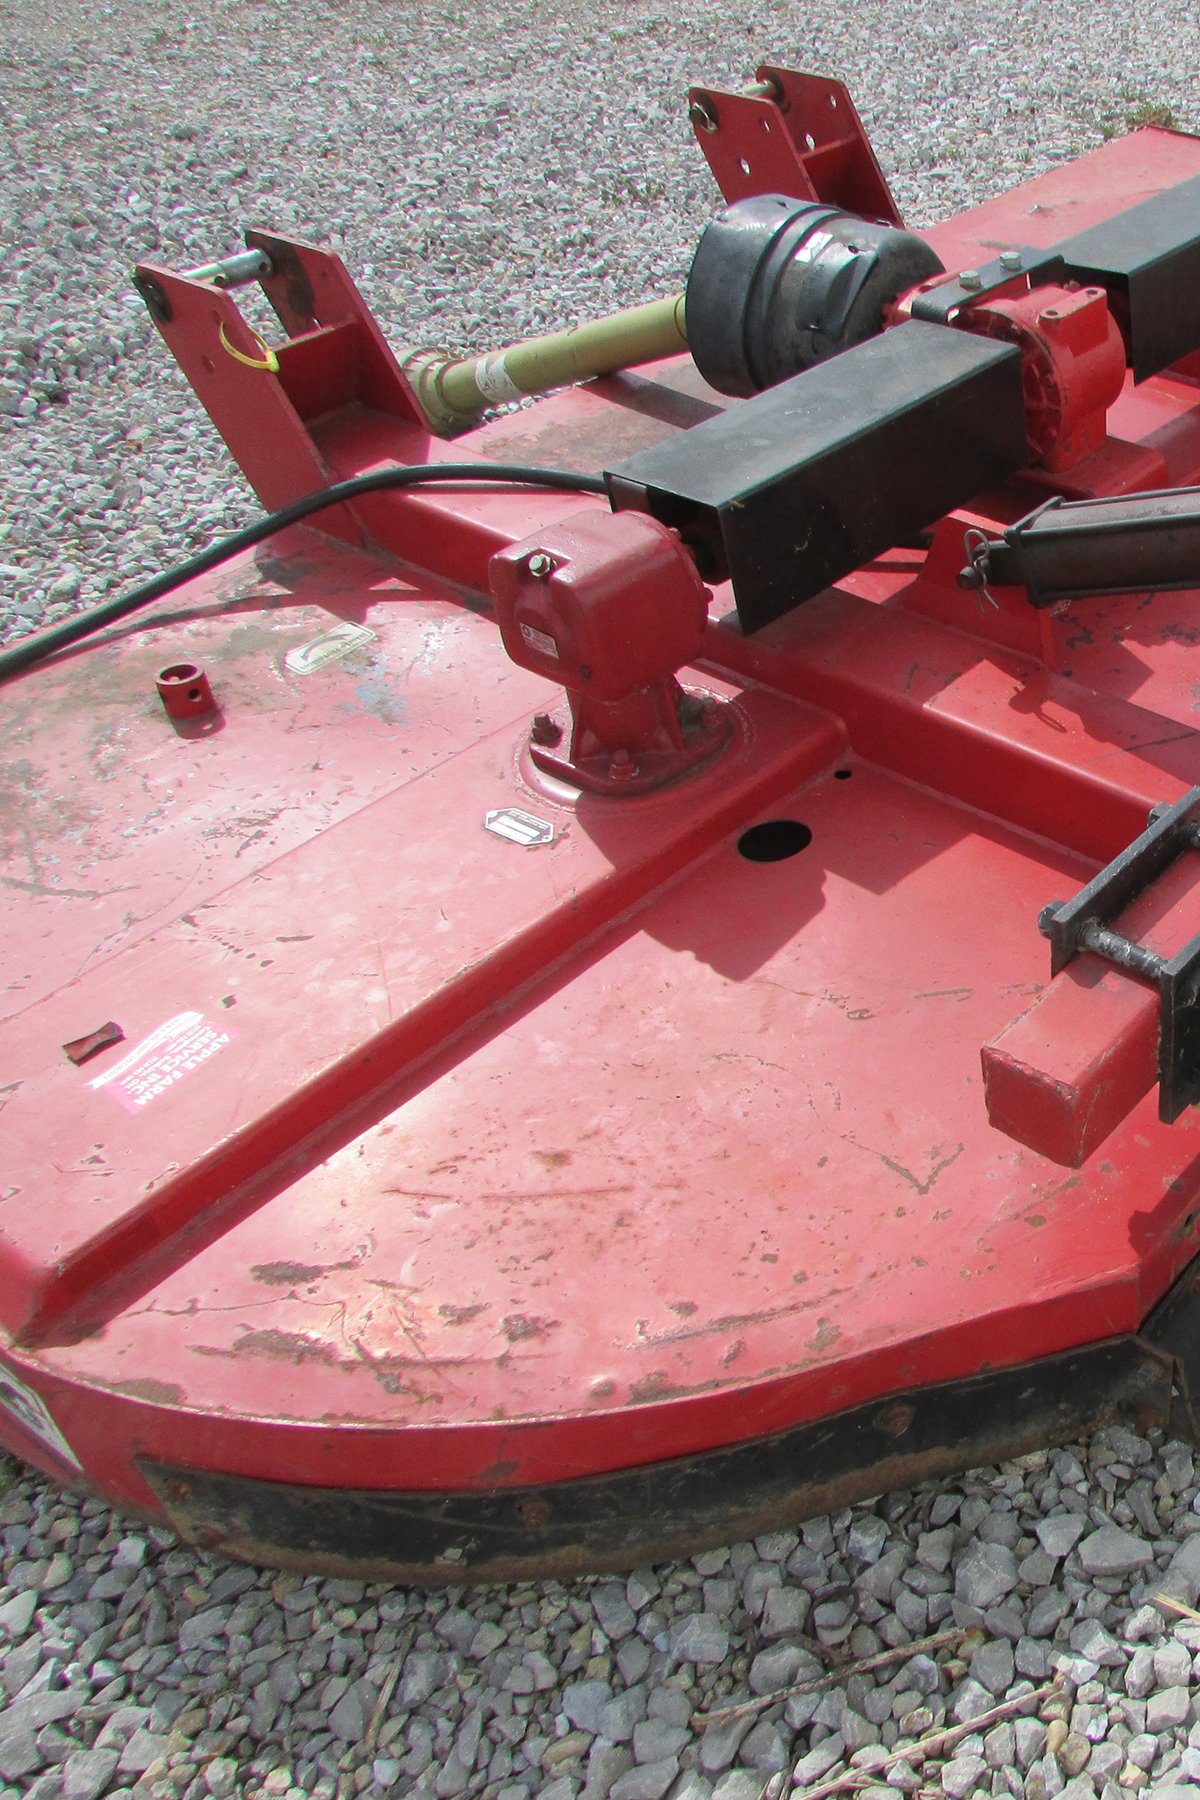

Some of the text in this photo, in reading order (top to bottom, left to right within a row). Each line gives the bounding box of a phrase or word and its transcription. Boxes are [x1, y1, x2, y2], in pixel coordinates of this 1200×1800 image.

[125, 1029, 218, 1097] SERVICE INC.
[132, 1032, 232, 1106] APPLE FARM
